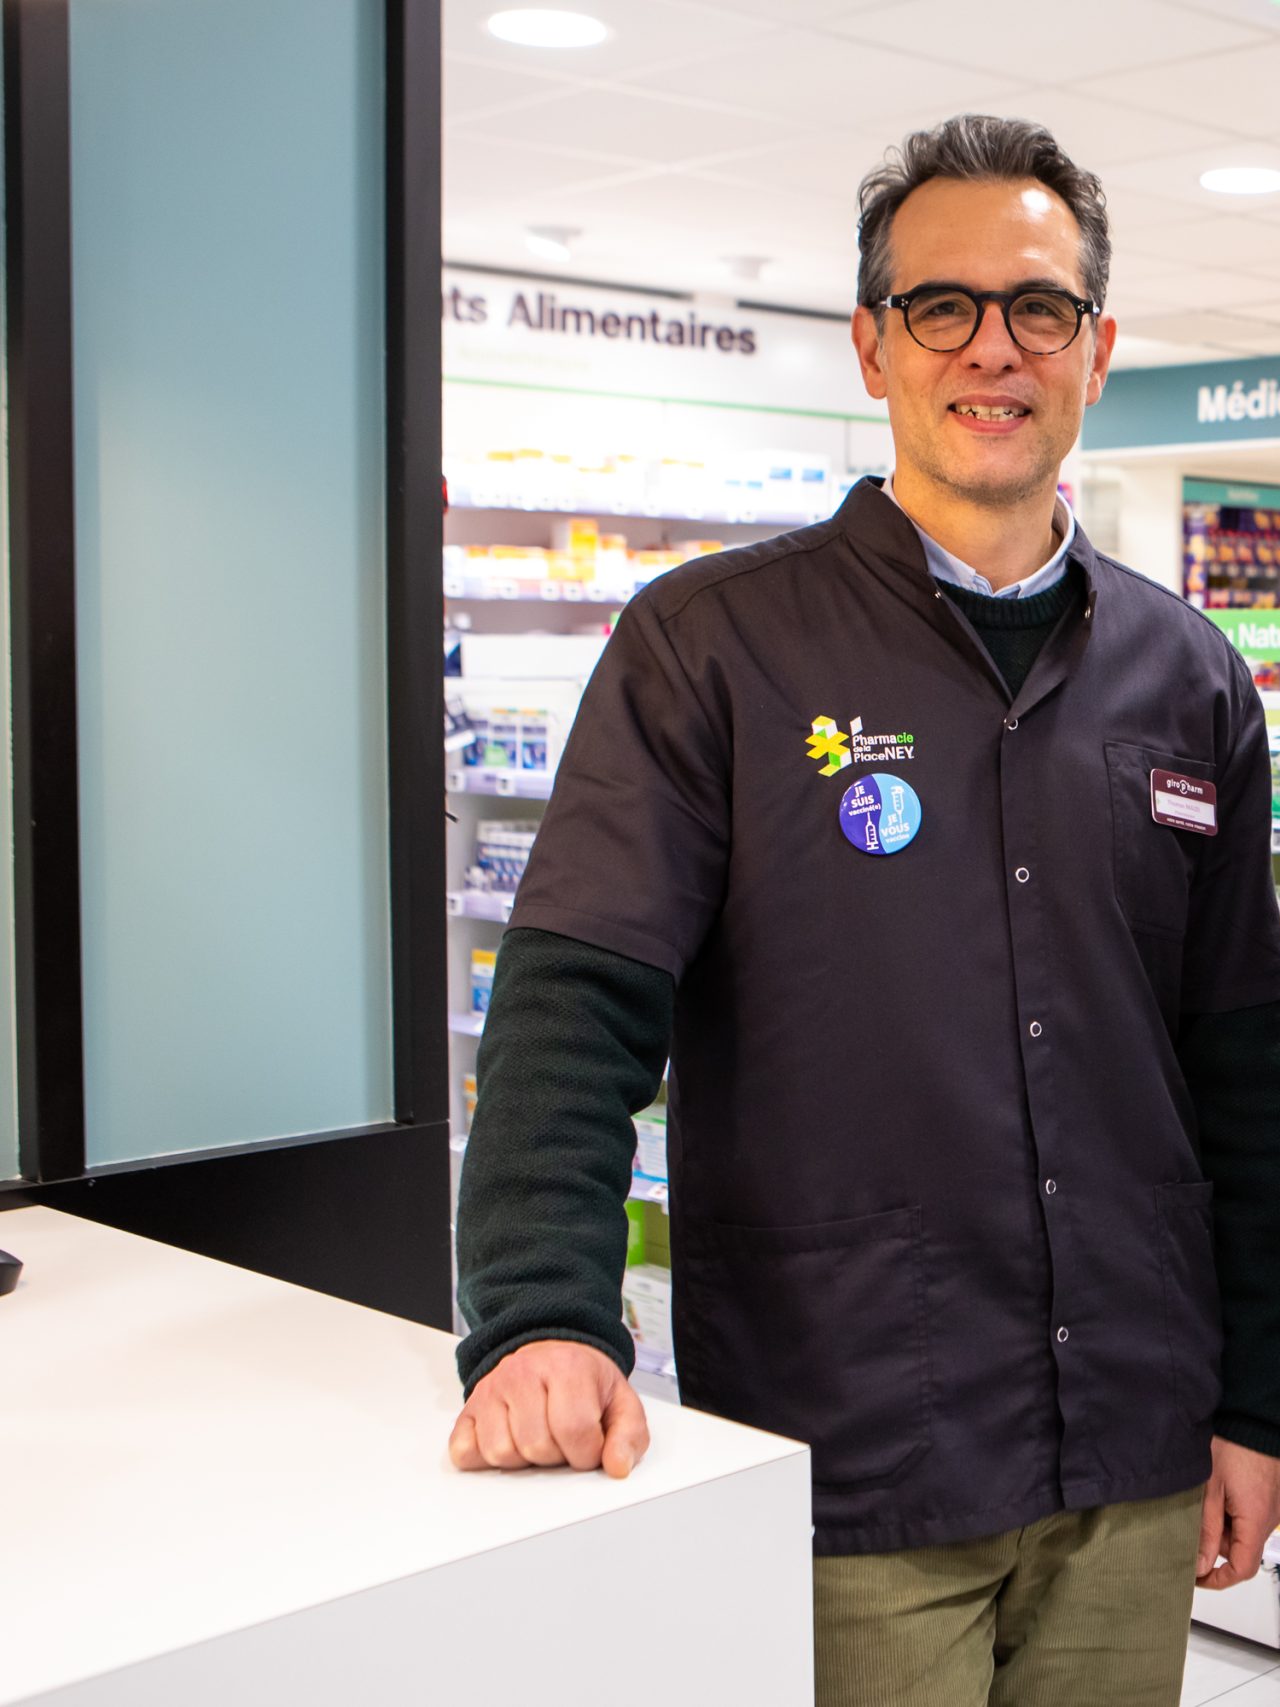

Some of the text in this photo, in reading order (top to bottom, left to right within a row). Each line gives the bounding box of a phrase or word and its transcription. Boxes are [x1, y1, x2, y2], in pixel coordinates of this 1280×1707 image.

[507, 291, 757, 354] Alimentaires
[852, 732, 914, 747] Pharmacie
[855, 785, 866, 798] JE
[851, 795, 874, 809] SUIS
[887, 813, 898, 826] JE
[881, 822, 910, 837] VOUS
